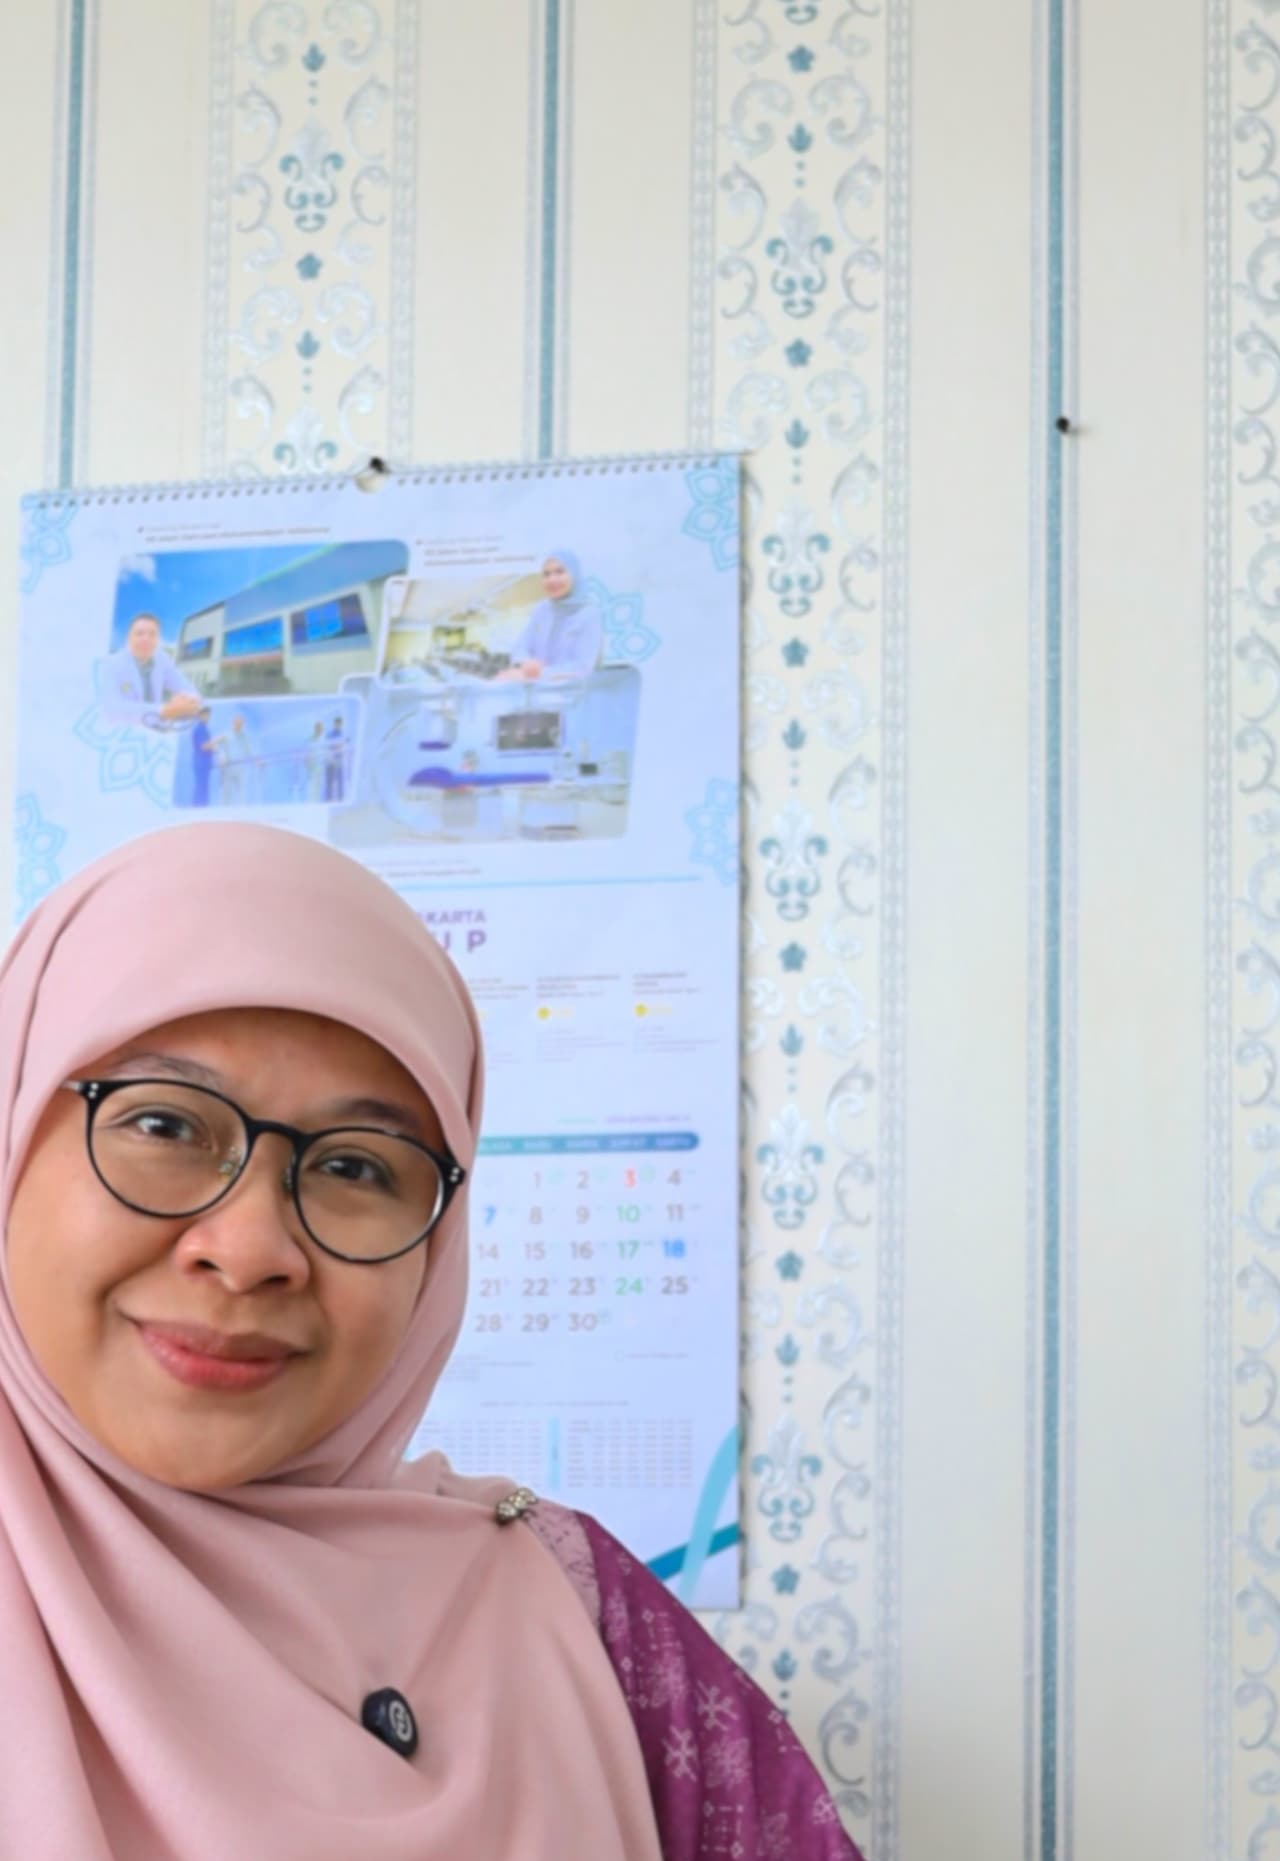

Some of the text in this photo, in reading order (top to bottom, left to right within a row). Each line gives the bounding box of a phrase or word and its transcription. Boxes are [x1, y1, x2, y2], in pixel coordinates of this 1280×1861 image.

[417, 909, 486, 925] KARTA
[576, 1170, 589, 1189] 2
[668, 1169, 681, 1186] 4
[484, 1204, 684, 1224] 7 8 9 10 11
[477, 1243, 499, 1260] 14
[524, 1242, 545, 1260] 15
[570, 1241, 593, 1259] 16
[617, 1240, 640, 1259] 17
[480, 1276, 688, 1297] 21 22 23 24 25
[475, 1313, 598, 1332] 28 29 30
